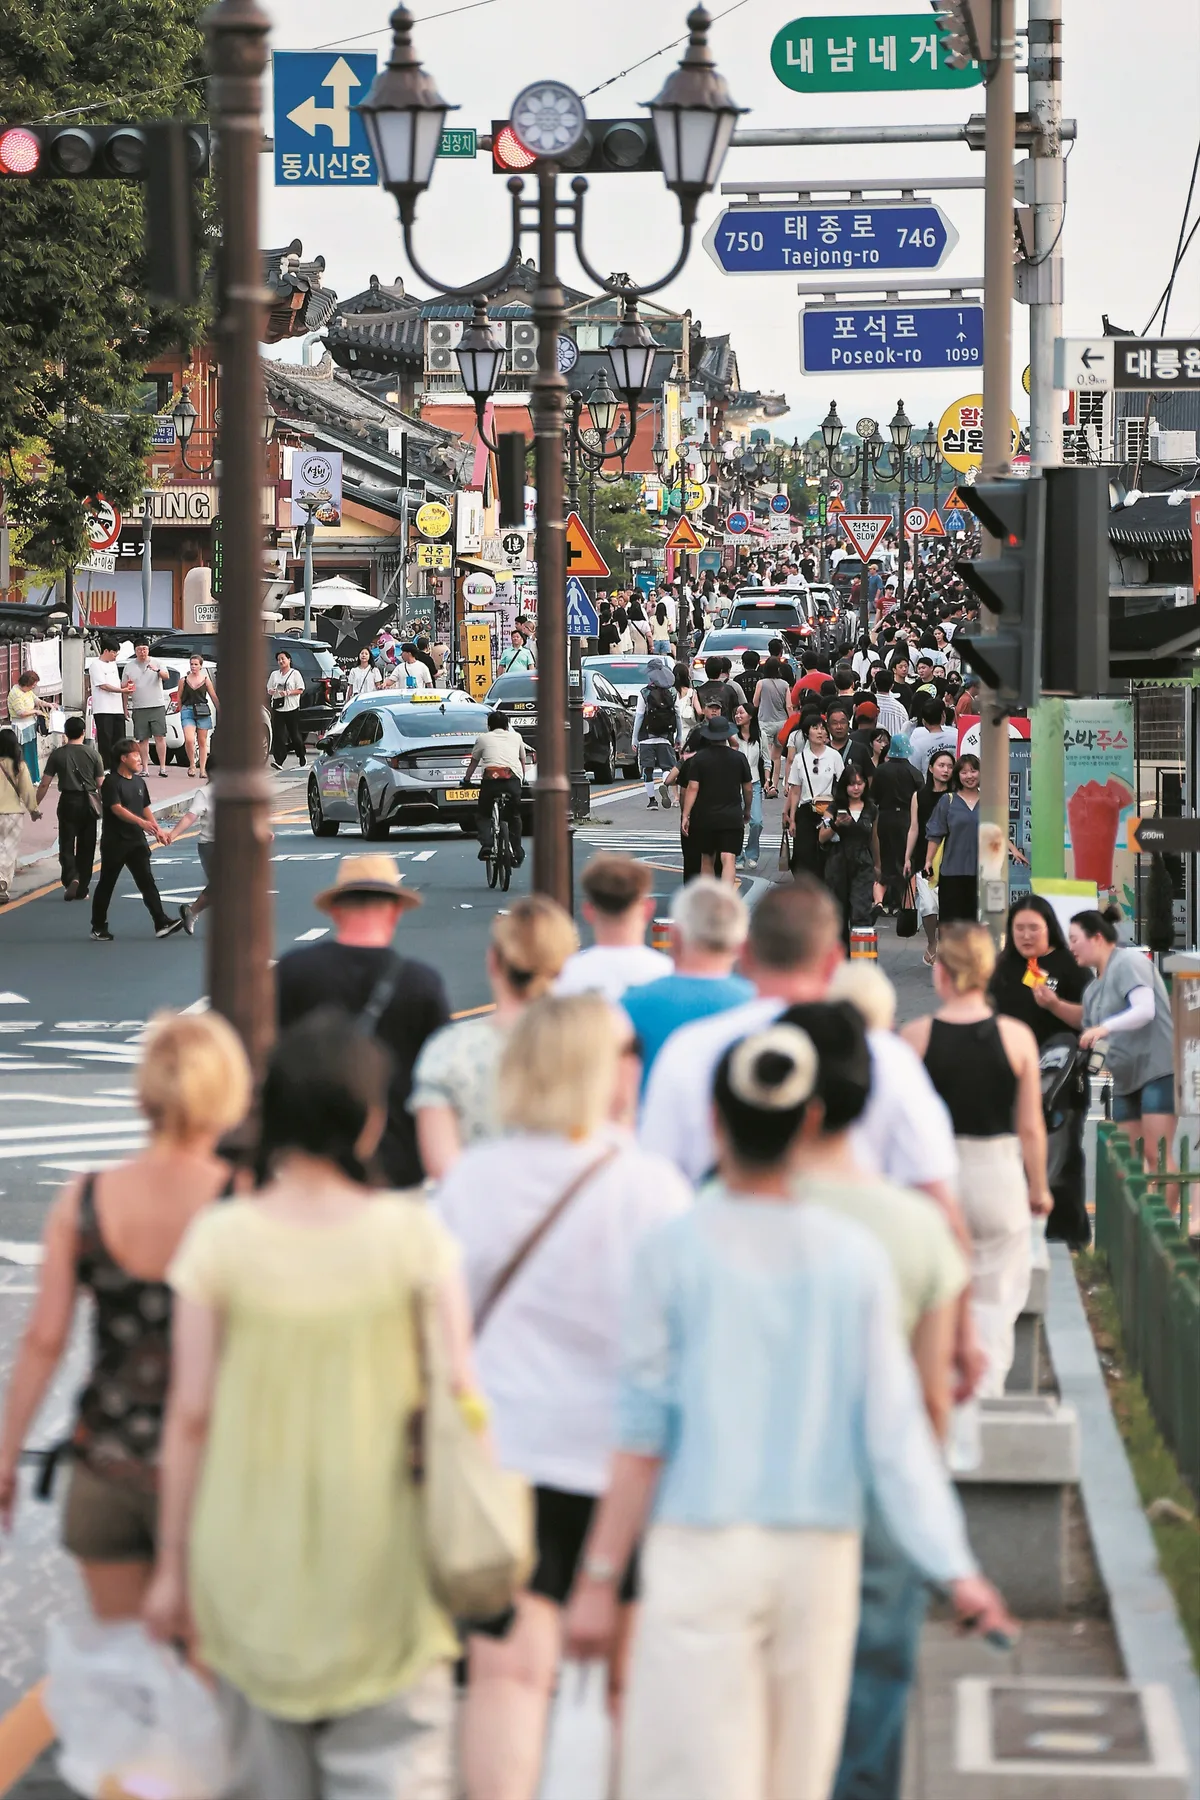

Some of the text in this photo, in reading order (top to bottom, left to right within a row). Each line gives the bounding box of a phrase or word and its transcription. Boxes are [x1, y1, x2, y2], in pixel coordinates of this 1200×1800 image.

[786, 35, 979, 74] 내남네거
[440, 134, 471, 152] 집장치
[281, 153, 372, 180] 동시신호
[784, 214, 876, 245] 태종로
[896, 228, 936, 249] 746
[725, 231, 764, 252] 750
[781, 248, 880, 268] Taejong-ro
[957, 312, 963, 325] 1
[833, 314, 919, 343] 포석로
[831, 347, 922, 365] Poseok-ro
[946, 348, 979, 361] 1099
[1077, 374, 1107, 386] 0.9km
[960, 407, 983, 428] 황
[122, 493, 210, 518] BING
[852, 522, 879, 532] 천천히
[909, 515, 921, 526] 30
[856, 532, 876, 540] SLOW
[567, 625, 592, 634] 단보도
[1064, 730, 1129, 752] 수박주스
[1141, 831, 1165, 840] 200m
